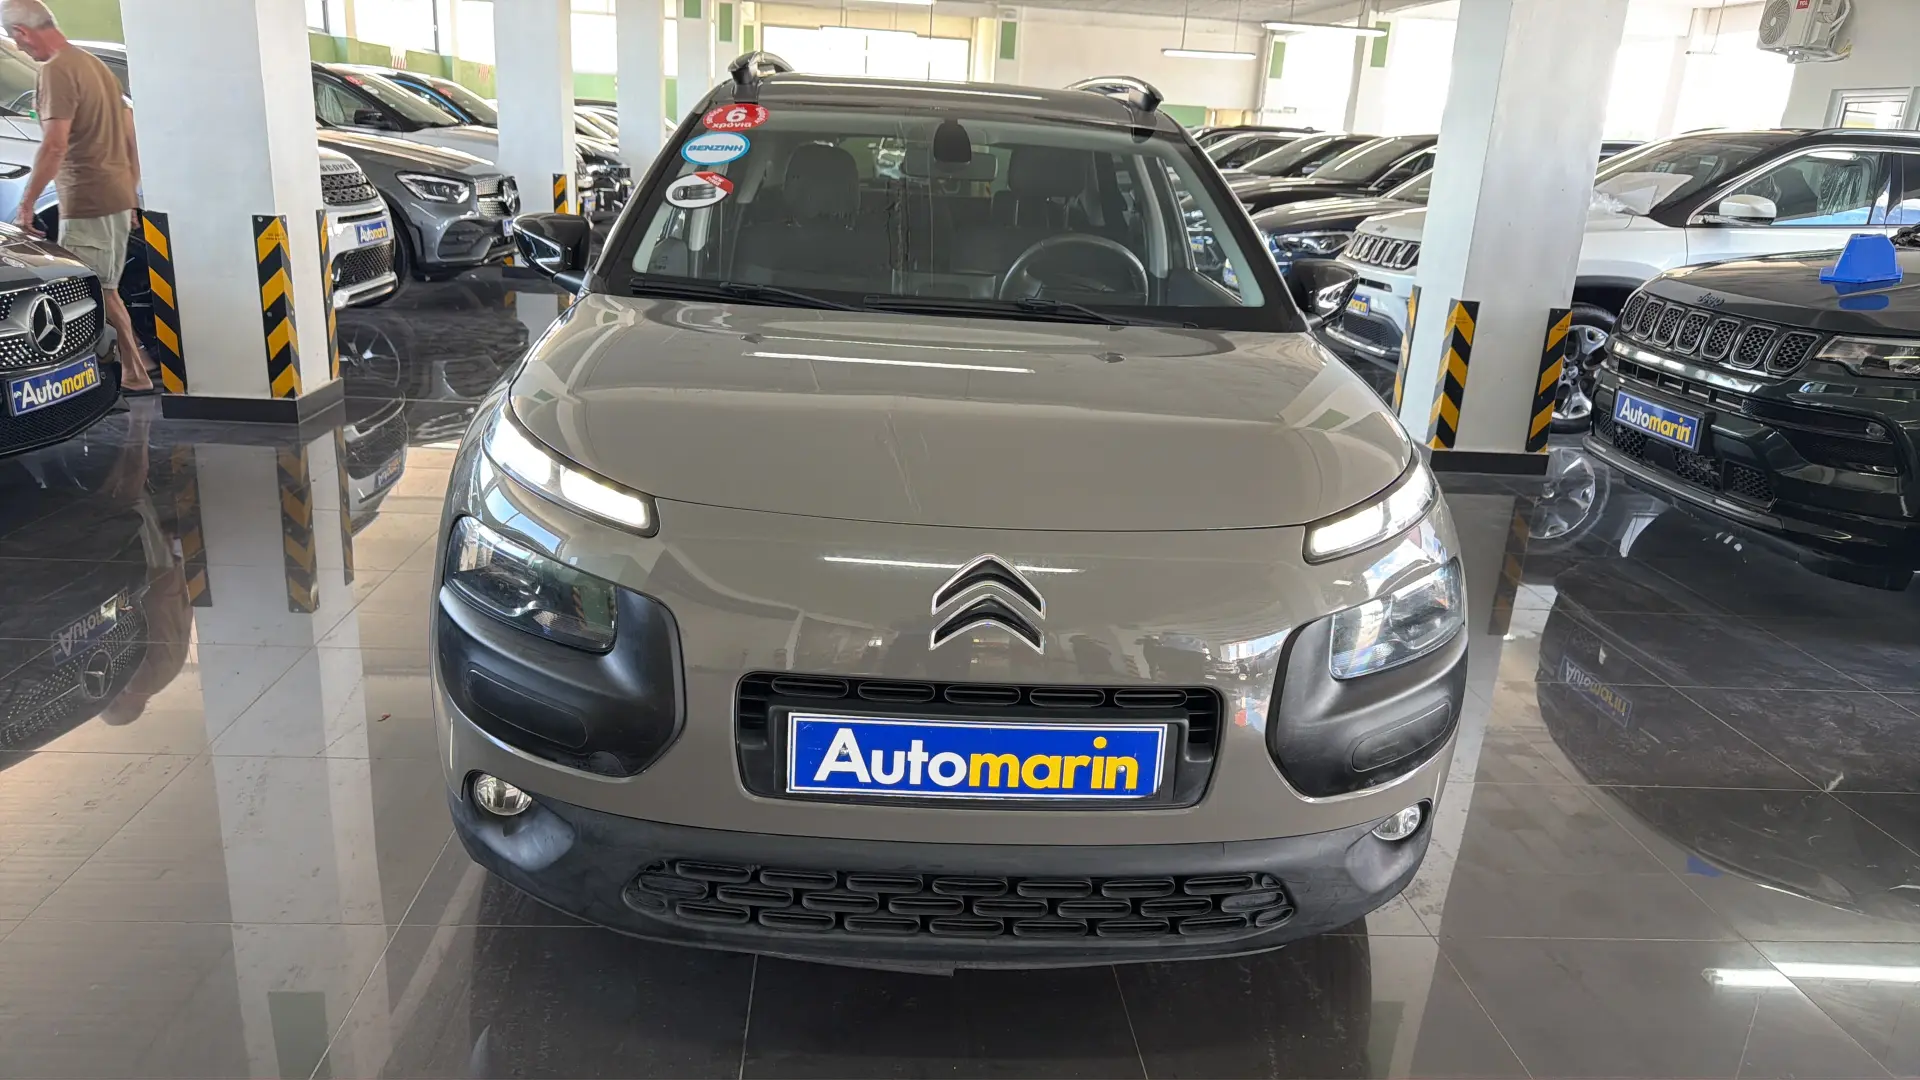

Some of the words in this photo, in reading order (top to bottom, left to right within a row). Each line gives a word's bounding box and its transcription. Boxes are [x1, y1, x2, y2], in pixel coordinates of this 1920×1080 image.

[726, 108, 747, 122] 6
[21, 361, 97, 409] Automarin
[1619, 397, 1692, 443] Automarin
[813, 727, 1139, 790] Automarin
